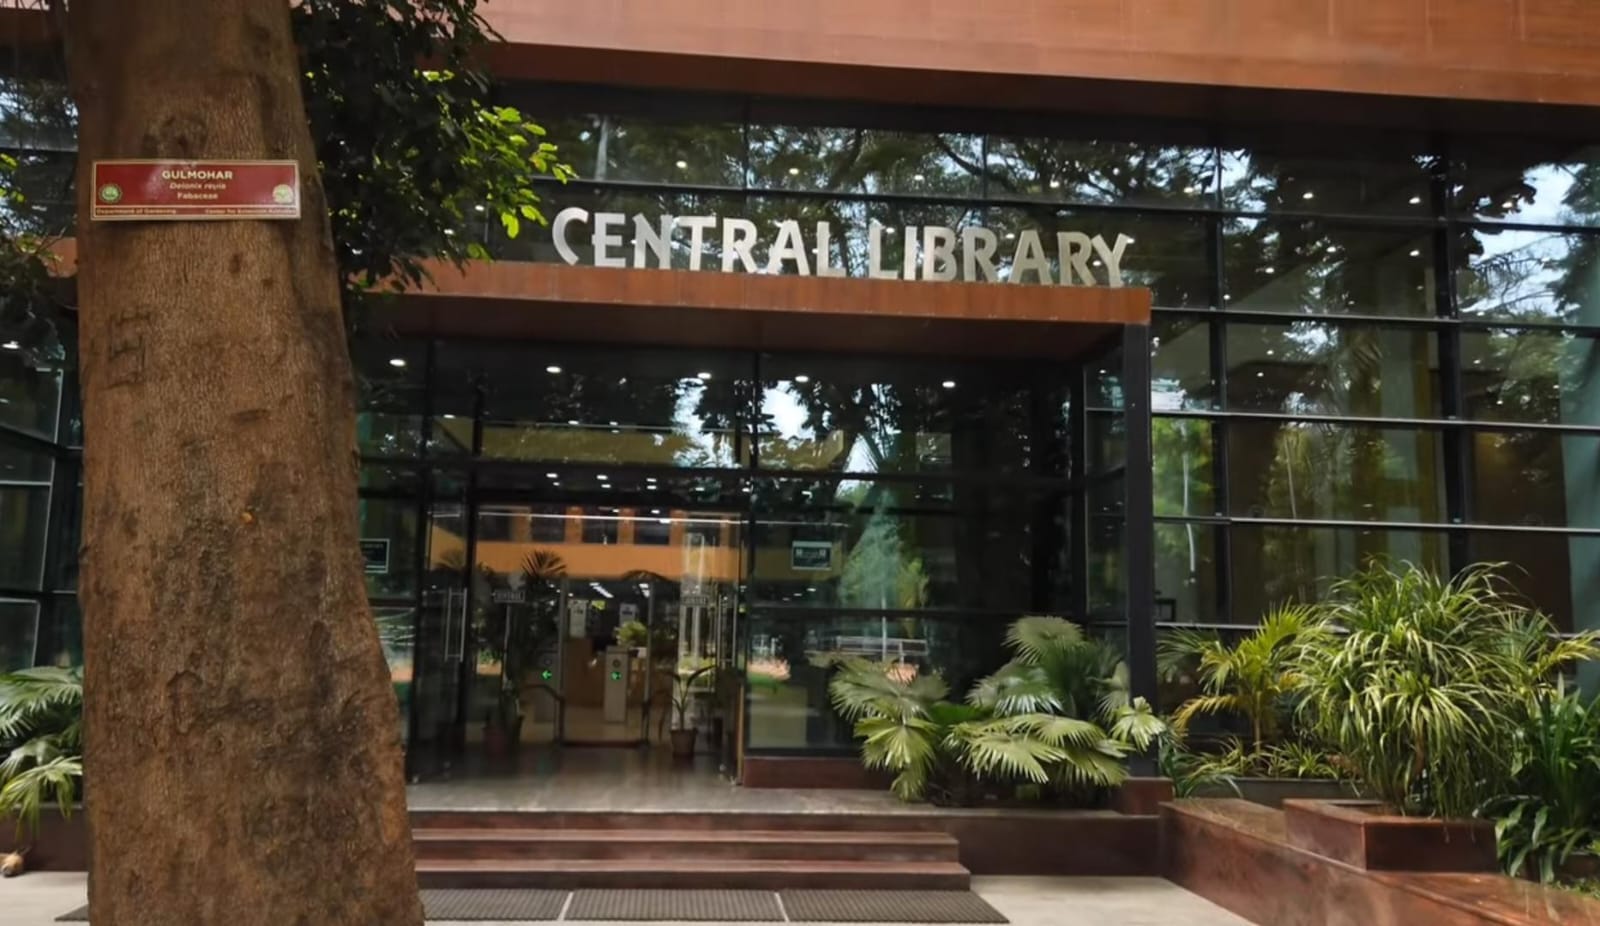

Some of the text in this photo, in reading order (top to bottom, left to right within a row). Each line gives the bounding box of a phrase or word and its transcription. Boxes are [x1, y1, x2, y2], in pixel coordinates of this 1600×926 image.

[162, 170, 233, 180] GULMOHAR
[552, 207, 1128, 287] CENTRAL LIBRARY
